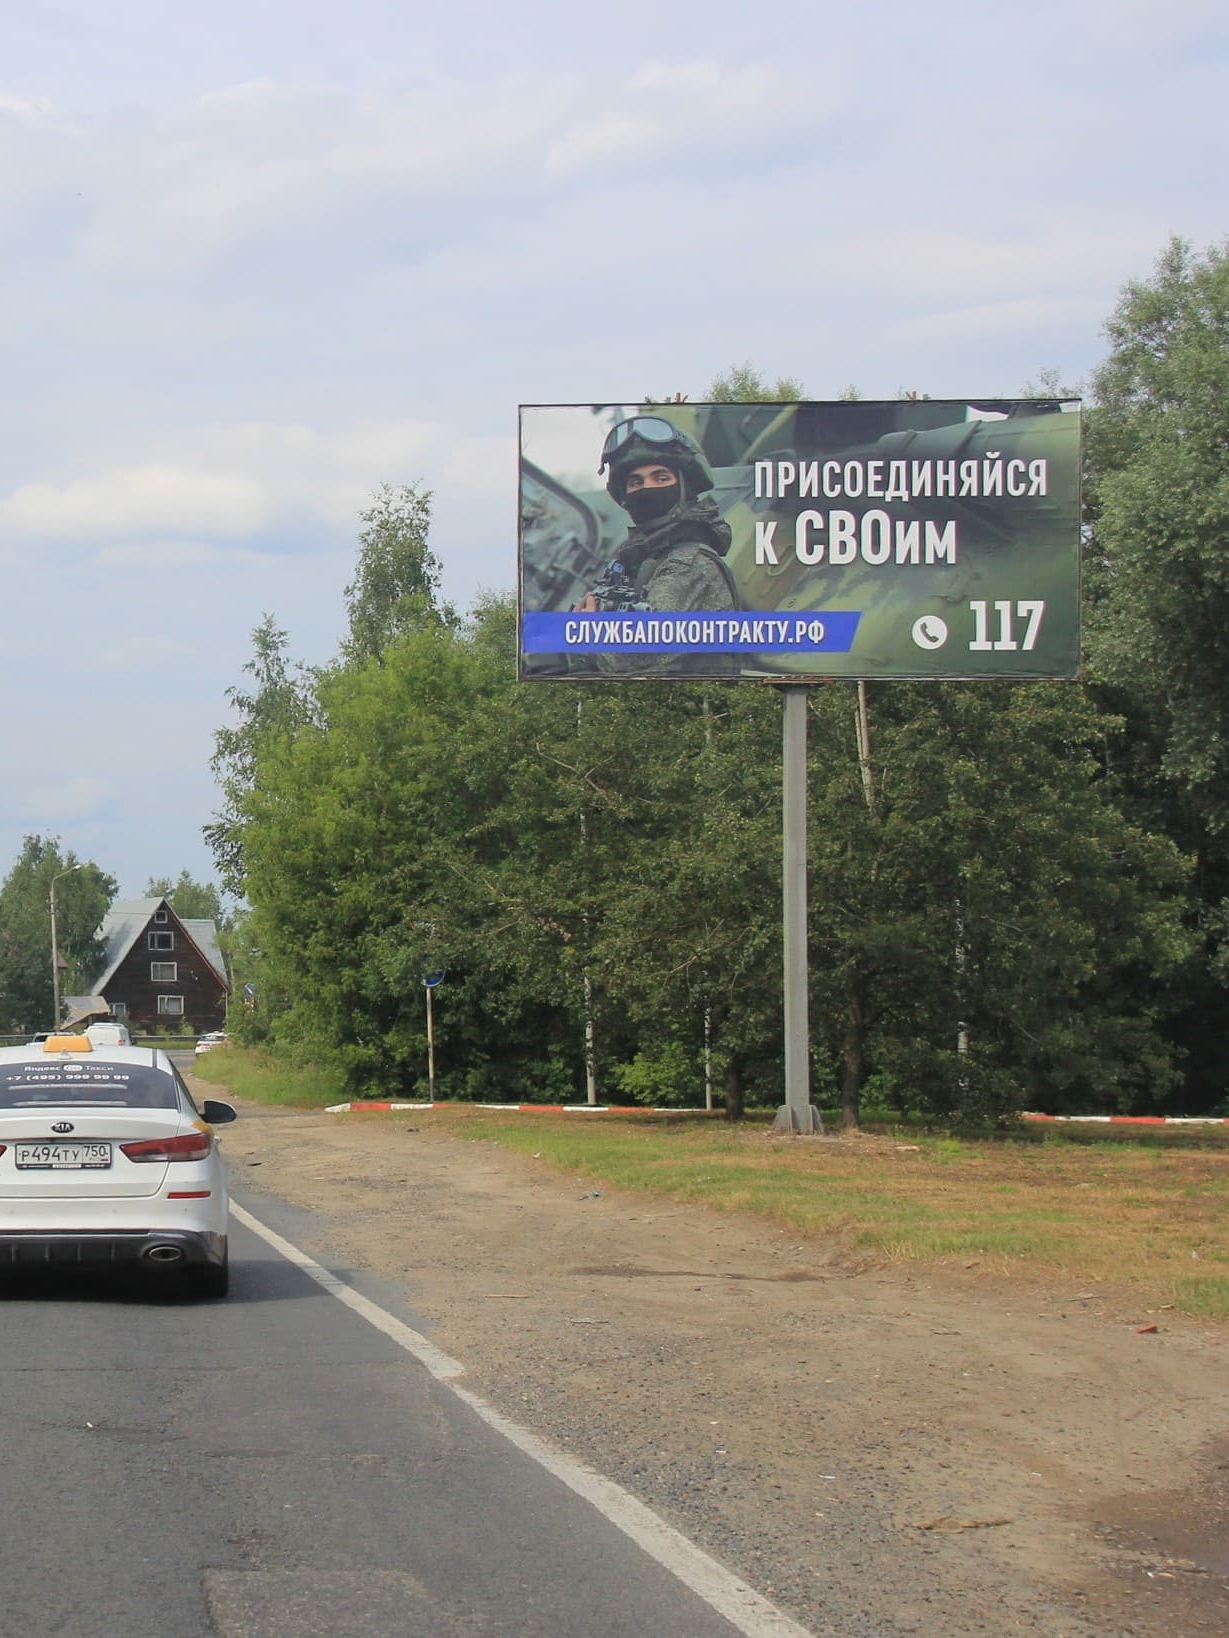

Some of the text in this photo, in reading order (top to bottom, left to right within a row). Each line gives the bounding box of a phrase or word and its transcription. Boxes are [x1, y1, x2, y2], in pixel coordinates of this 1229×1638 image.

[754, 452, 1048, 502] ПРИСОЕДИНЯЙСЯ
[795, 509, 957, 565] СВОим
[564, 619, 825, 645] СЛУЖБАПОКОНТРАКТУ.РФ
[969, 600, 1045, 651] 117
[54, 1122, 72, 1132] KIA
[83, 1145, 106, 1157] 750
